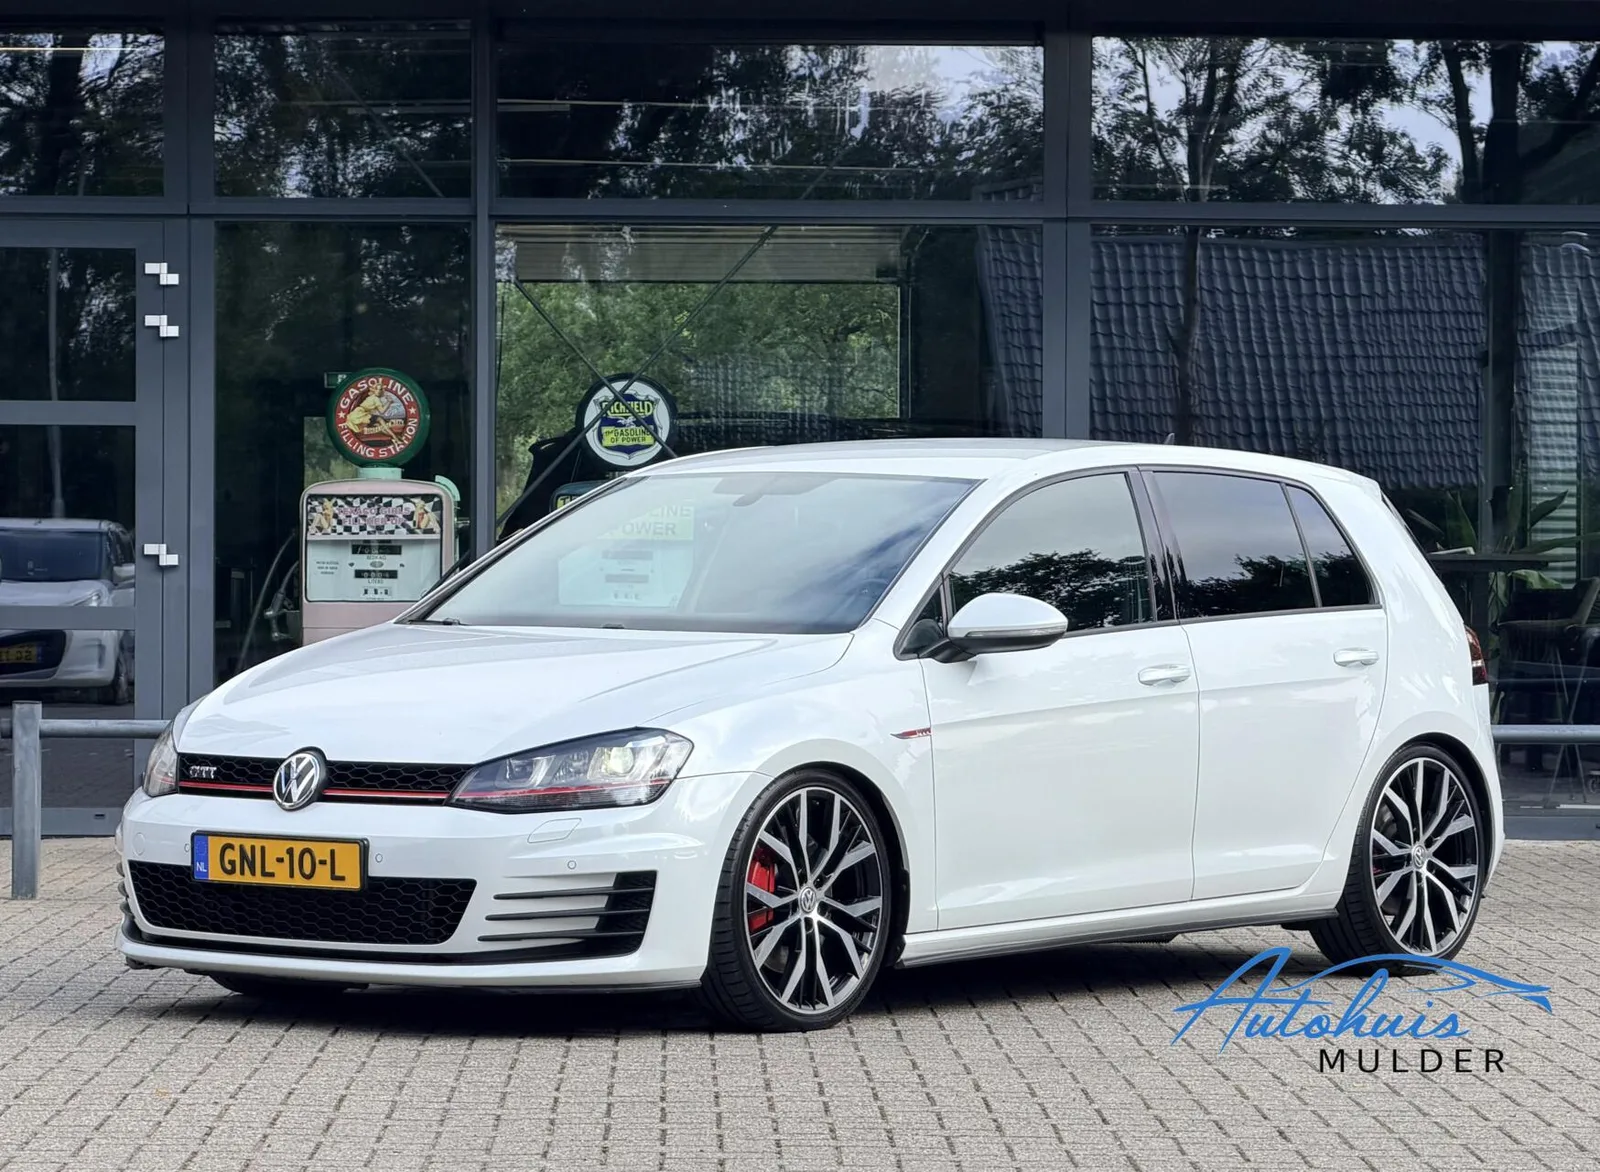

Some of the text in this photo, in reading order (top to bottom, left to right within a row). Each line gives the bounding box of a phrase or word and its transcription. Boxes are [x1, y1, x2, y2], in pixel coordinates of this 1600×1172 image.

[340, 377, 414, 409] GASOLINE
[338, 423, 375, 457] FILLING
[379, 418, 418, 457] STATION
[380, 507, 411, 515] GIRLS
[196, 861, 207, 872] NL
[219, 842, 346, 882] GNL-10-L
